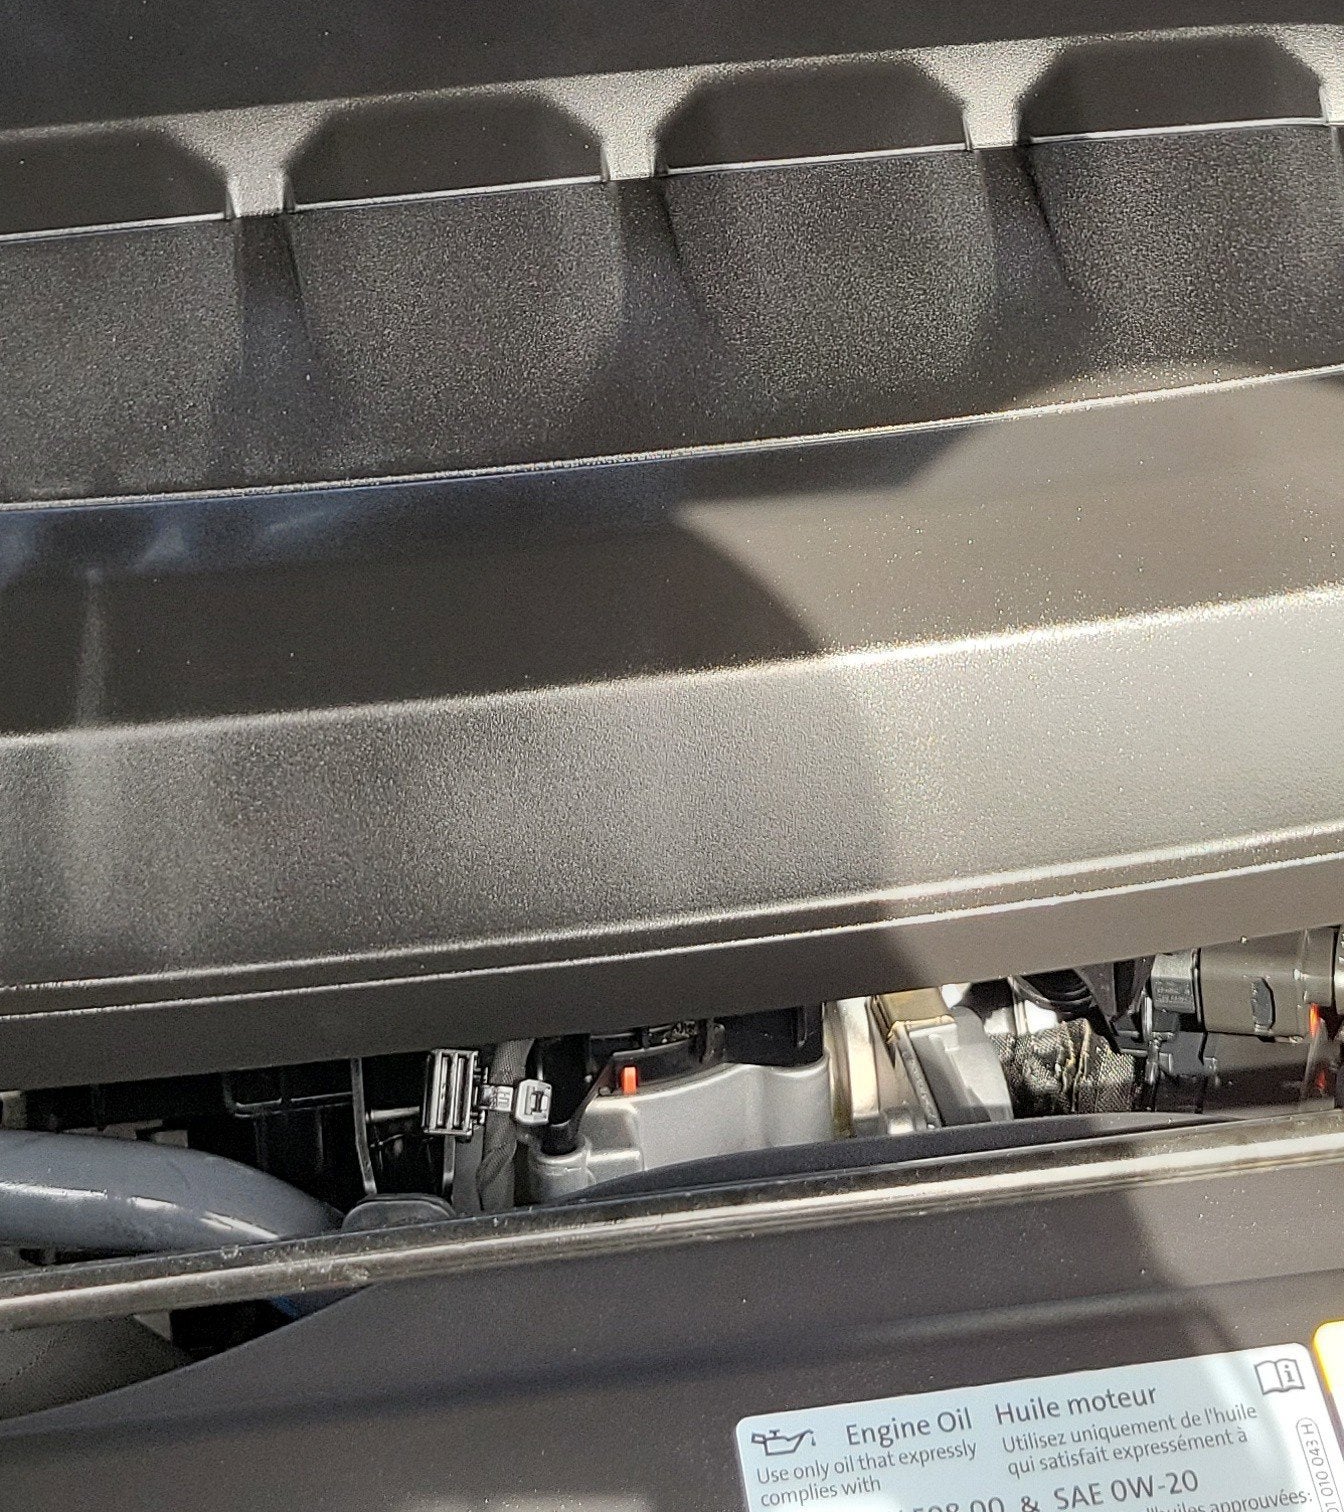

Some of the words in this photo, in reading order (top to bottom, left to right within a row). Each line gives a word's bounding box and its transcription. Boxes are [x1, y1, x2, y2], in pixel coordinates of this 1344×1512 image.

[846, 1417, 931, 1448] Engine
[937, 1406, 973, 1433] Oil
[995, 1395, 1062, 1425] Huile
[1067, 1387, 1158, 1416] moteur
[1002, 1429, 1067, 1454] Utilisez
[1070, 1417, 1177, 1446] uniquement
[1181, 1408, 1203, 1429] de
[1205, 1403, 1258, 1425] l'huile
[1301, 1423, 1315, 1435] H
[756, 1466, 789, 1485] Use
[793, 1458, 830, 1481] only
[834, 1455, 855, 1474] oil
[858, 1450, 895, 1471] that
[898, 1440, 978, 1466] expressly
[1008, 1458, 1036, 1481] qui
[1039, 1445, 1111, 1470] satisfait
[1113, 1429, 1235, 1461] expressément
[1238, 1426, 1249, 1444] à
[1306, 1439, 1325, 1467] 043
[760, 1485, 839, 1508] complies
[841, 1476, 882, 1496] with
[1053, 1481, 1105, 1511] SAE
[1111, 1468, 1200, 1503] 0W-20
[1316, 1471, 1334, 1497] 010
